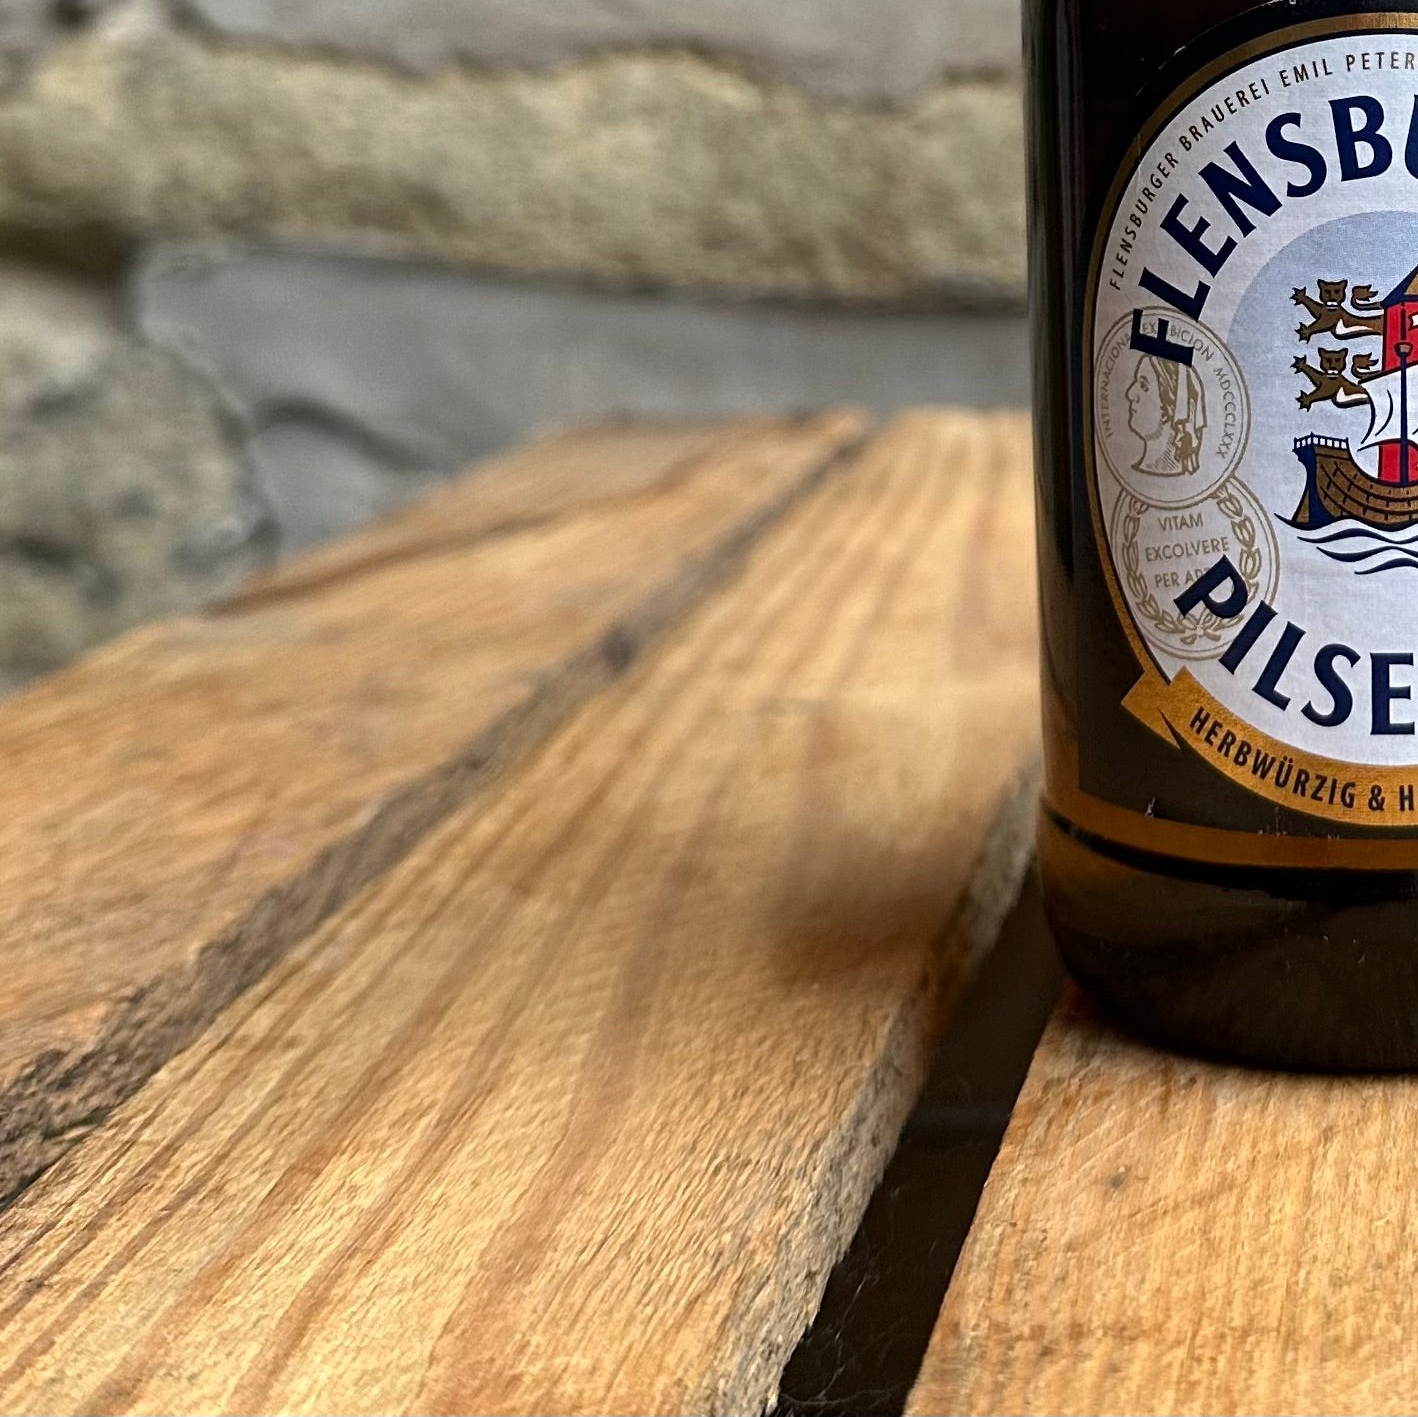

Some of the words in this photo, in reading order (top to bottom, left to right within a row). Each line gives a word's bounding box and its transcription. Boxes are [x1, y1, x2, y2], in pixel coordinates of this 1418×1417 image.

[1109, 151, 1180, 291] FLENSBURGER
[1178, 78, 1271, 152] BRAUEREI
[1278, 58, 1334, 88] EMIL
[1101, 333, 1132, 439] INTERNACIONA
[1144, 536, 1231, 562] EXCOLVERE
[1157, 512, 1204, 532] VITAM
[1154, 571, 1180, 589] PER
[1188, 706, 1356, 811] HERBWÜRZIG
[1367, 787, 1386, 813] &
